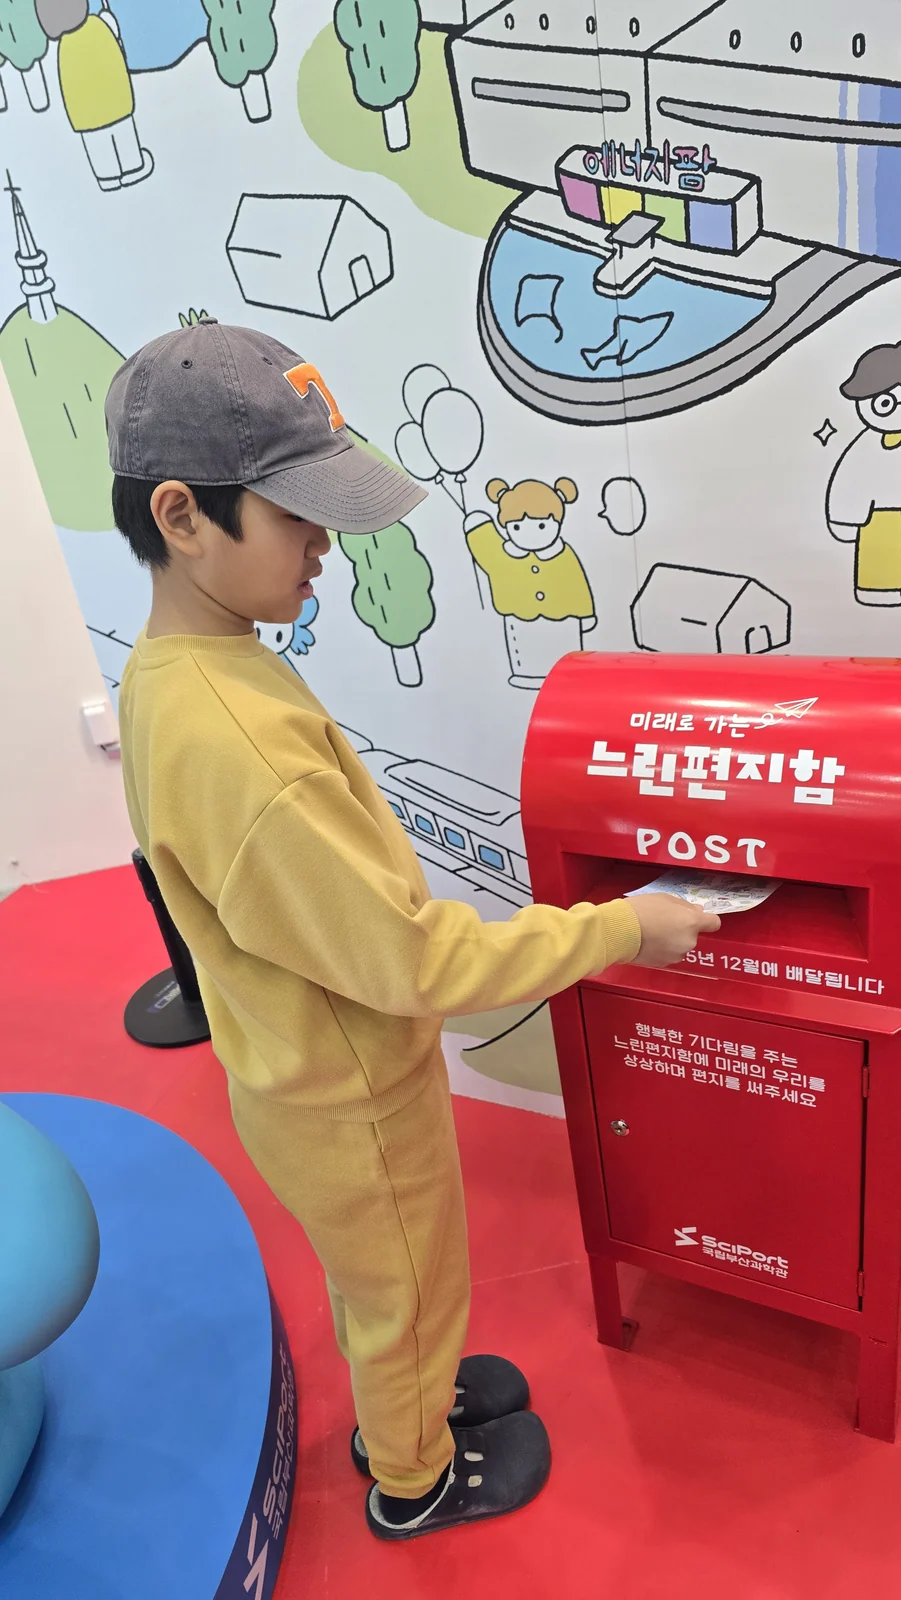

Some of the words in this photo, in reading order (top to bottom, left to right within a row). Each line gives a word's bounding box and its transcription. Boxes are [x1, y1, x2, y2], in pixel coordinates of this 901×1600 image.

[583, 138, 717, 192] 에너지팜
[283, 363, 345, 433] T
[630, 711, 695, 732] 미래로
[704, 713, 750, 738] 가는
[587, 741, 845, 805] 느린편지함
[636, 828, 766, 867] POST
[682, 950, 715, 967] 5년
[720, 955, 778, 978] 12월에
[785, 964, 885, 996] 배달됩니다
[614, 1035, 709, 1067] 느린편지함에
[715, 1056, 766, 1080] 미래의
[772, 1069, 826, 1093] 우리를
[635, 1022, 683, 1045] 행복한
[688, 1033, 757, 1060] 기다림을
[763, 1049, 798, 1069] 주는
[623, 1053, 686, 1079] 상상하며
[691, 1067, 741, 1091] 편지를
[746, 1081, 817, 1108] 써주세요
[702, 1246, 788, 1279] 국립부산과학관
